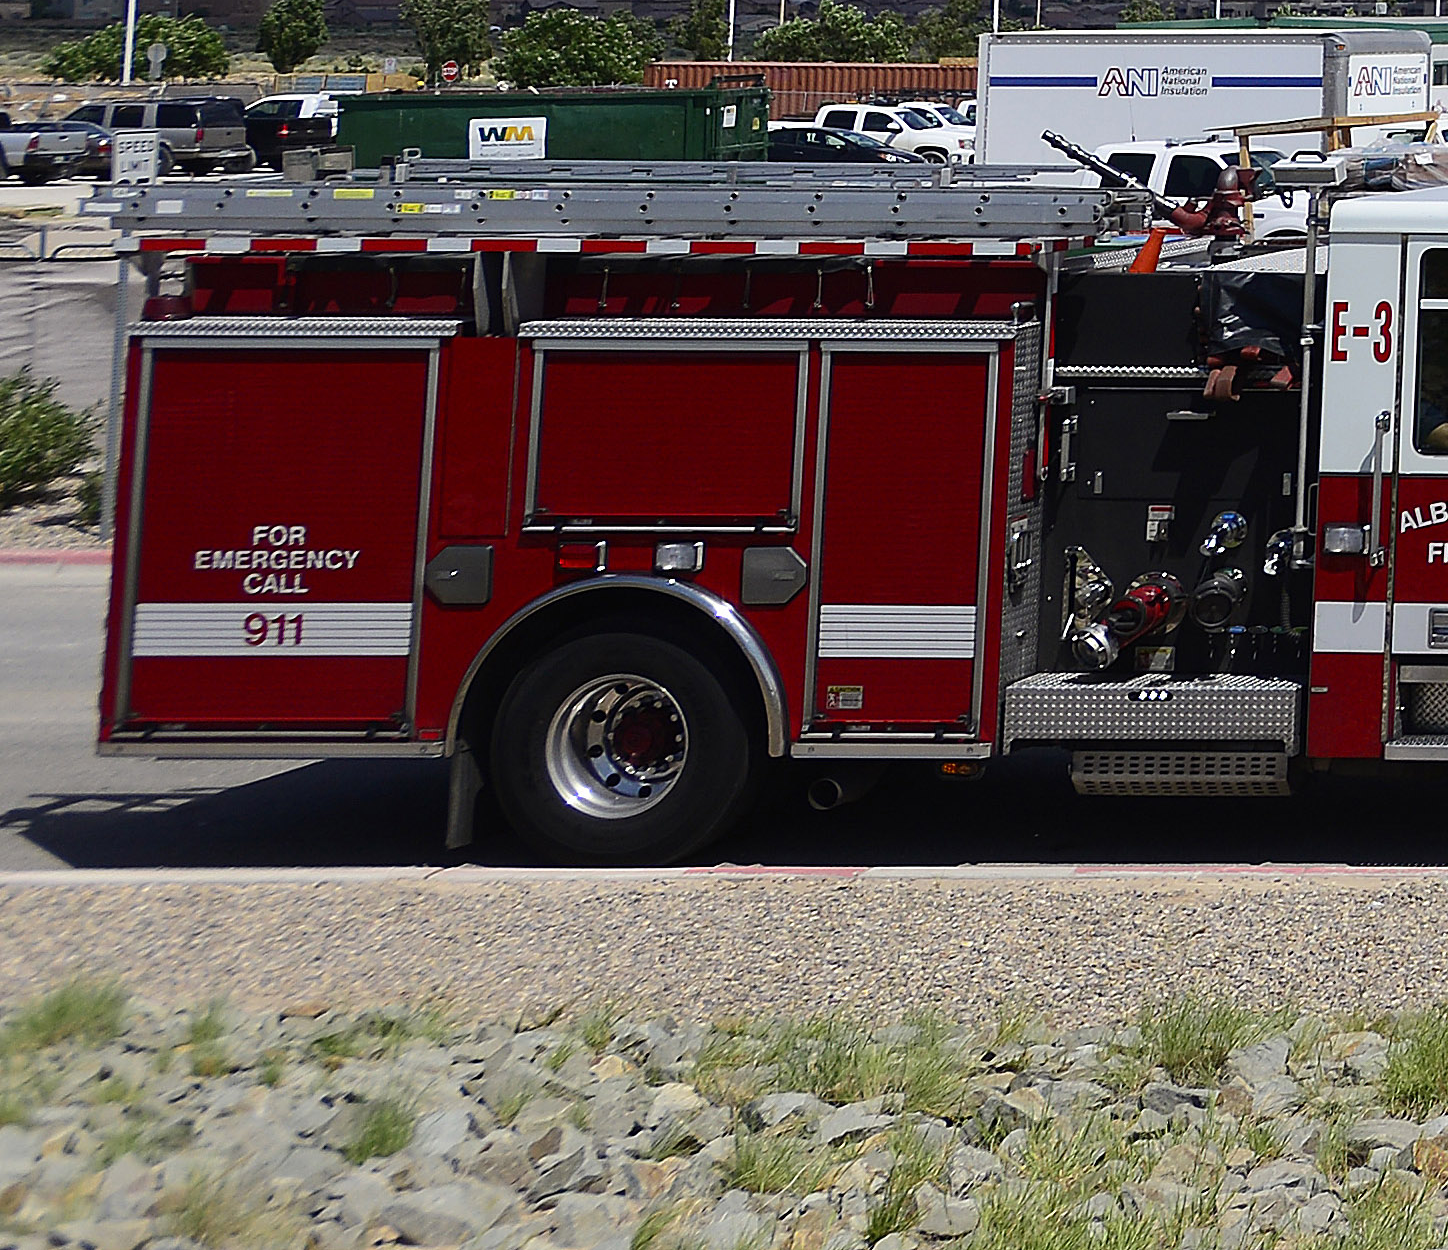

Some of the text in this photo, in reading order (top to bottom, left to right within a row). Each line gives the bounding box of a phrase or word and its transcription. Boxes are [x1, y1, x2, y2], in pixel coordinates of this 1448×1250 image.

[1098, 67, 1158, 97] ANI
[1161, 67, 1207, 76] American
[1161, 76, 1201, 86] National
[1354, 67, 1391, 96] ANI
[1161, 86, 1208, 96] Insulation
[478, 125, 535, 141] WM
[1331, 301, 1392, 363] E-3
[252, 525, 306, 546] FOR
[194, 550, 361, 569] EMERGENCY
[243, 573, 310, 594] CALL
[244, 612, 304, 646] 911
